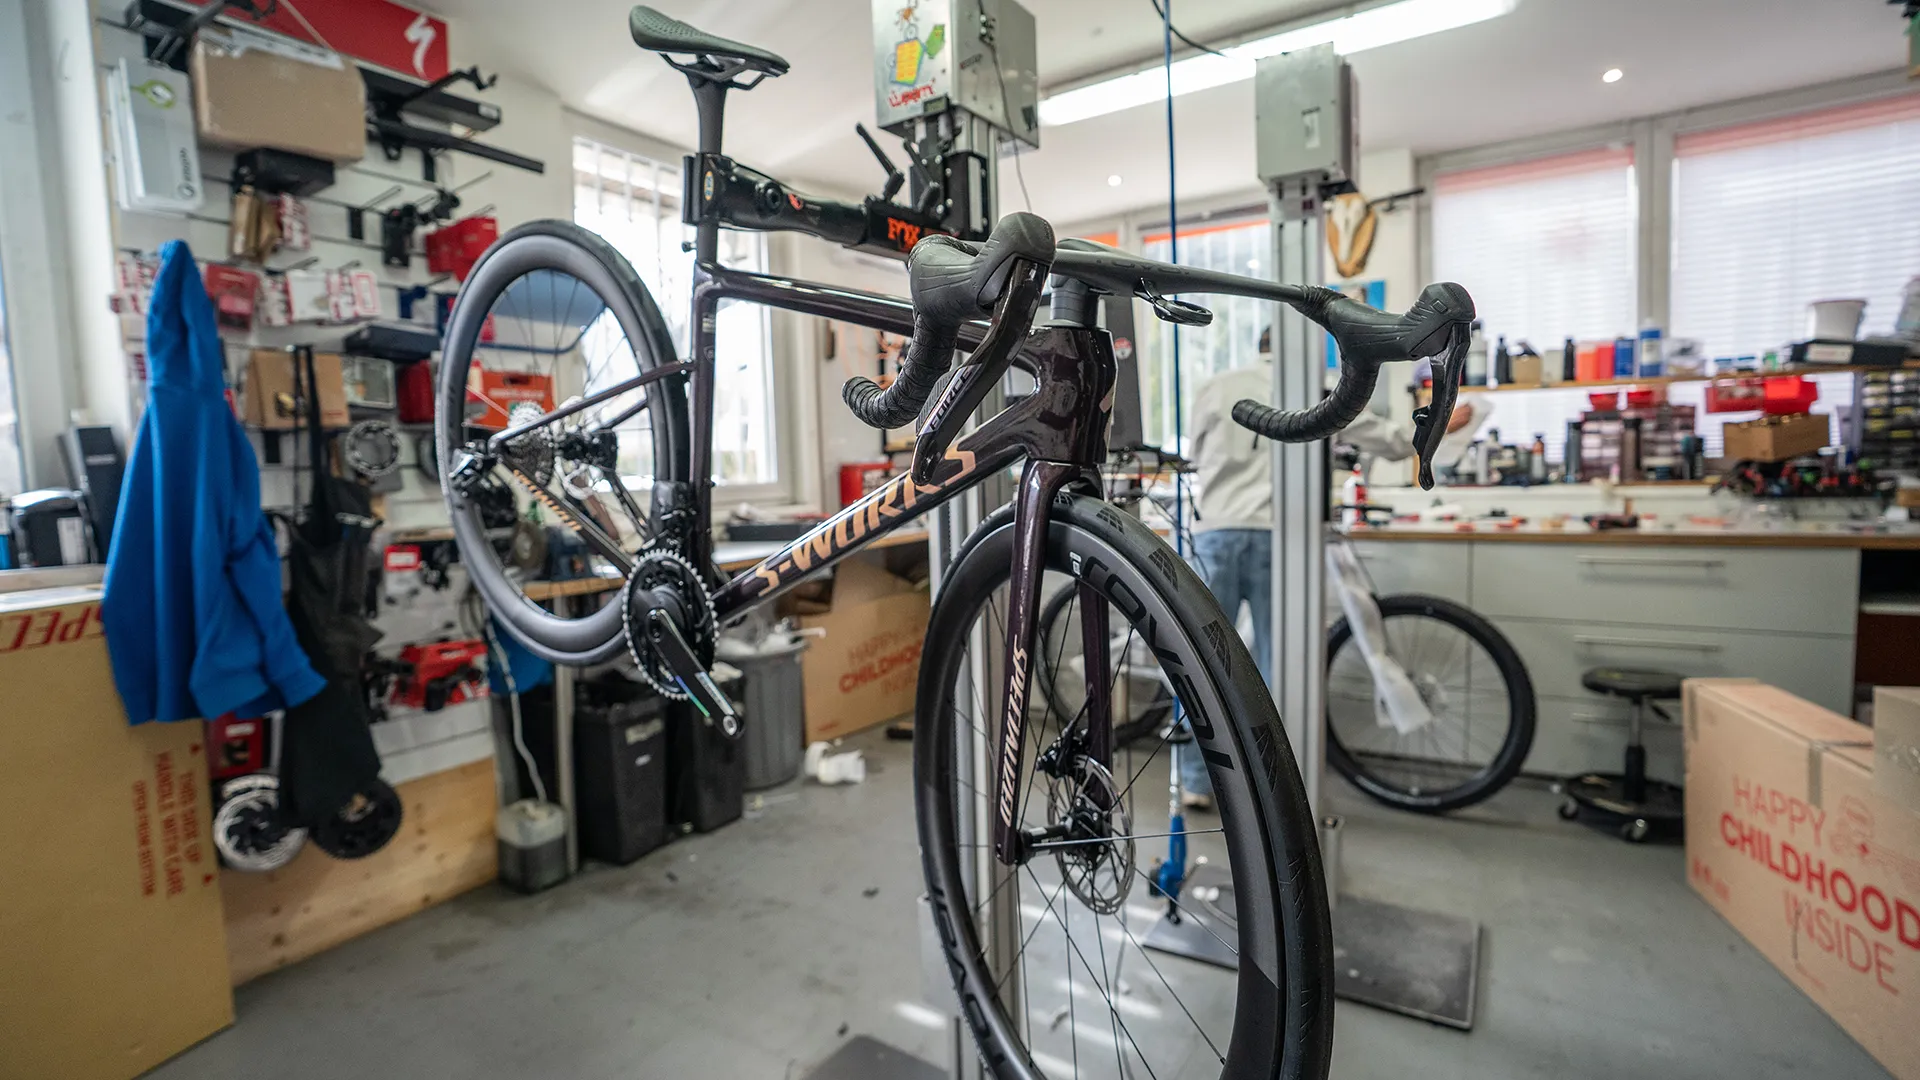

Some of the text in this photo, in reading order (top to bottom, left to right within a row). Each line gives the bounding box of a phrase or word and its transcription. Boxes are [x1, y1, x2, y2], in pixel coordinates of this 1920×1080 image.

[929, 367, 974, 431] FORCE
[756, 442, 976, 597] S-WORKS
[1000, 634, 1028, 828] SPECIALIZED
[1732, 774, 1826, 847] HAPPY
[1720, 812, 1920, 951] CHILDHOOD
[1784, 889, 1899, 995] INSIDE
